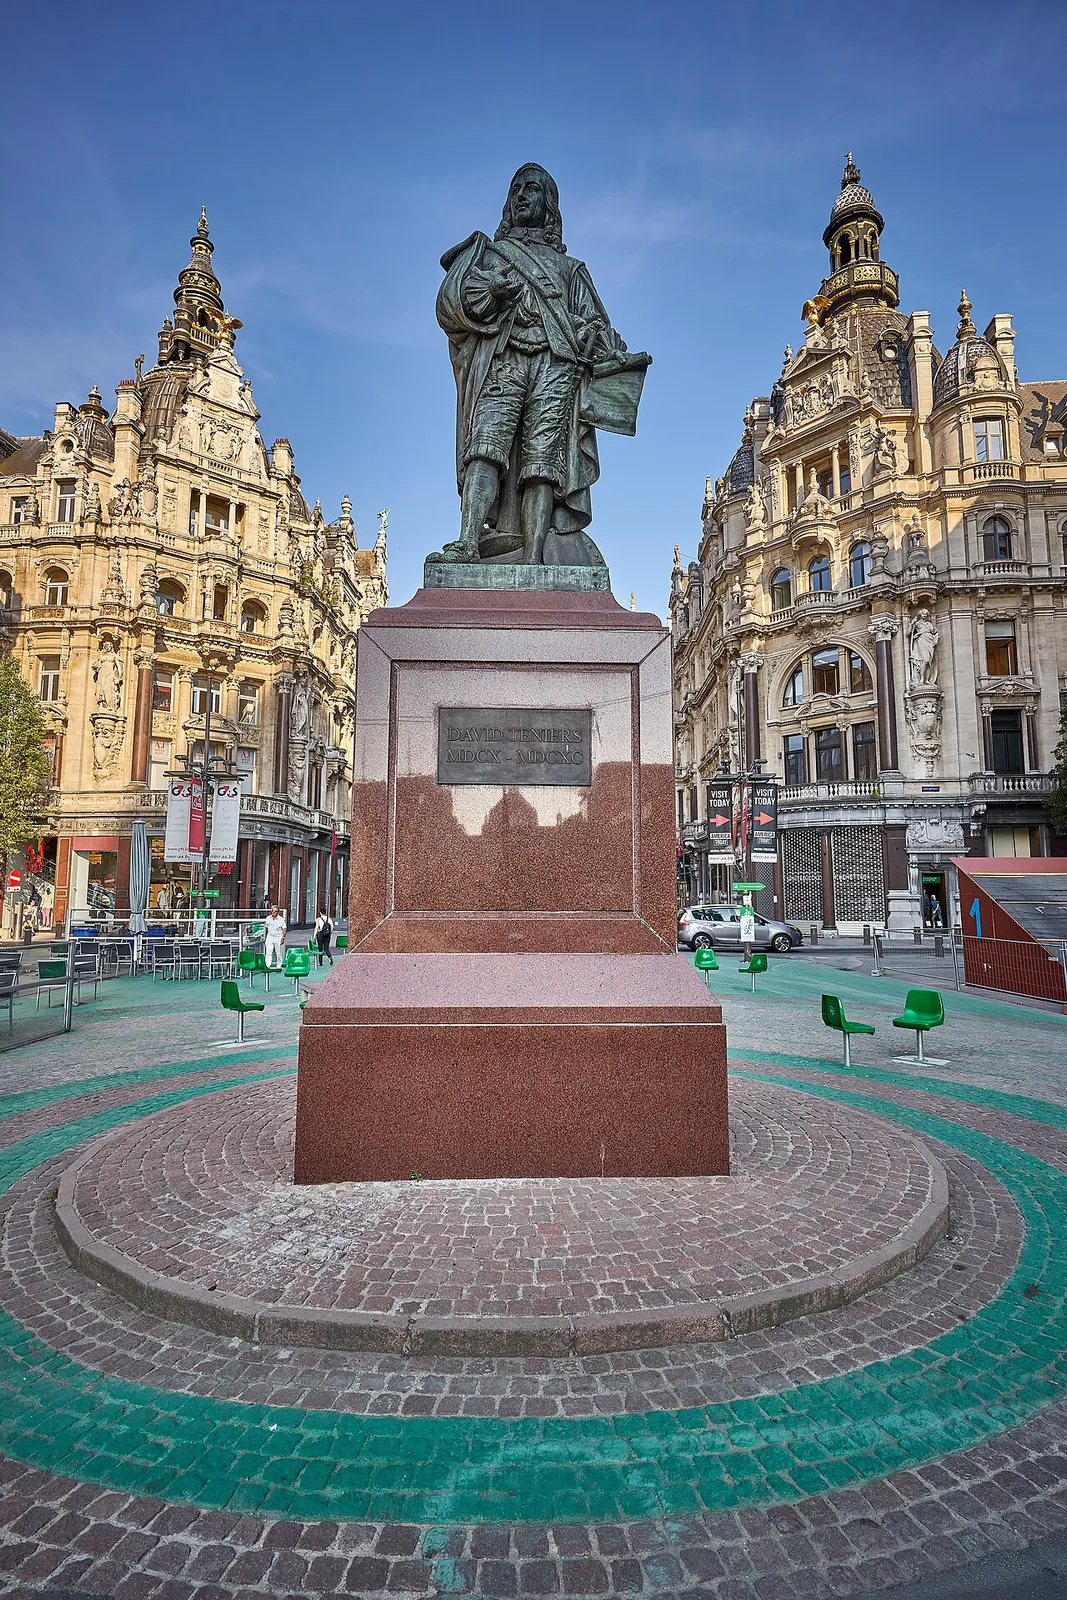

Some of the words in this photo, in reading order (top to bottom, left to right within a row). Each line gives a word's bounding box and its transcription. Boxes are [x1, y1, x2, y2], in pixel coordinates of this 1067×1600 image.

[447, 728, 503, 742] DAVID
[509, 729, 582, 743] TENIERS
[446, 750, 501, 763] MDCX
[516, 751, 583, 764] MDCXC
[711, 791, 728, 799] VISIT
[756, 789, 774, 797] VISIT
[709, 799, 730, 807] TODAY
[754, 797, 775, 805] TODAY
